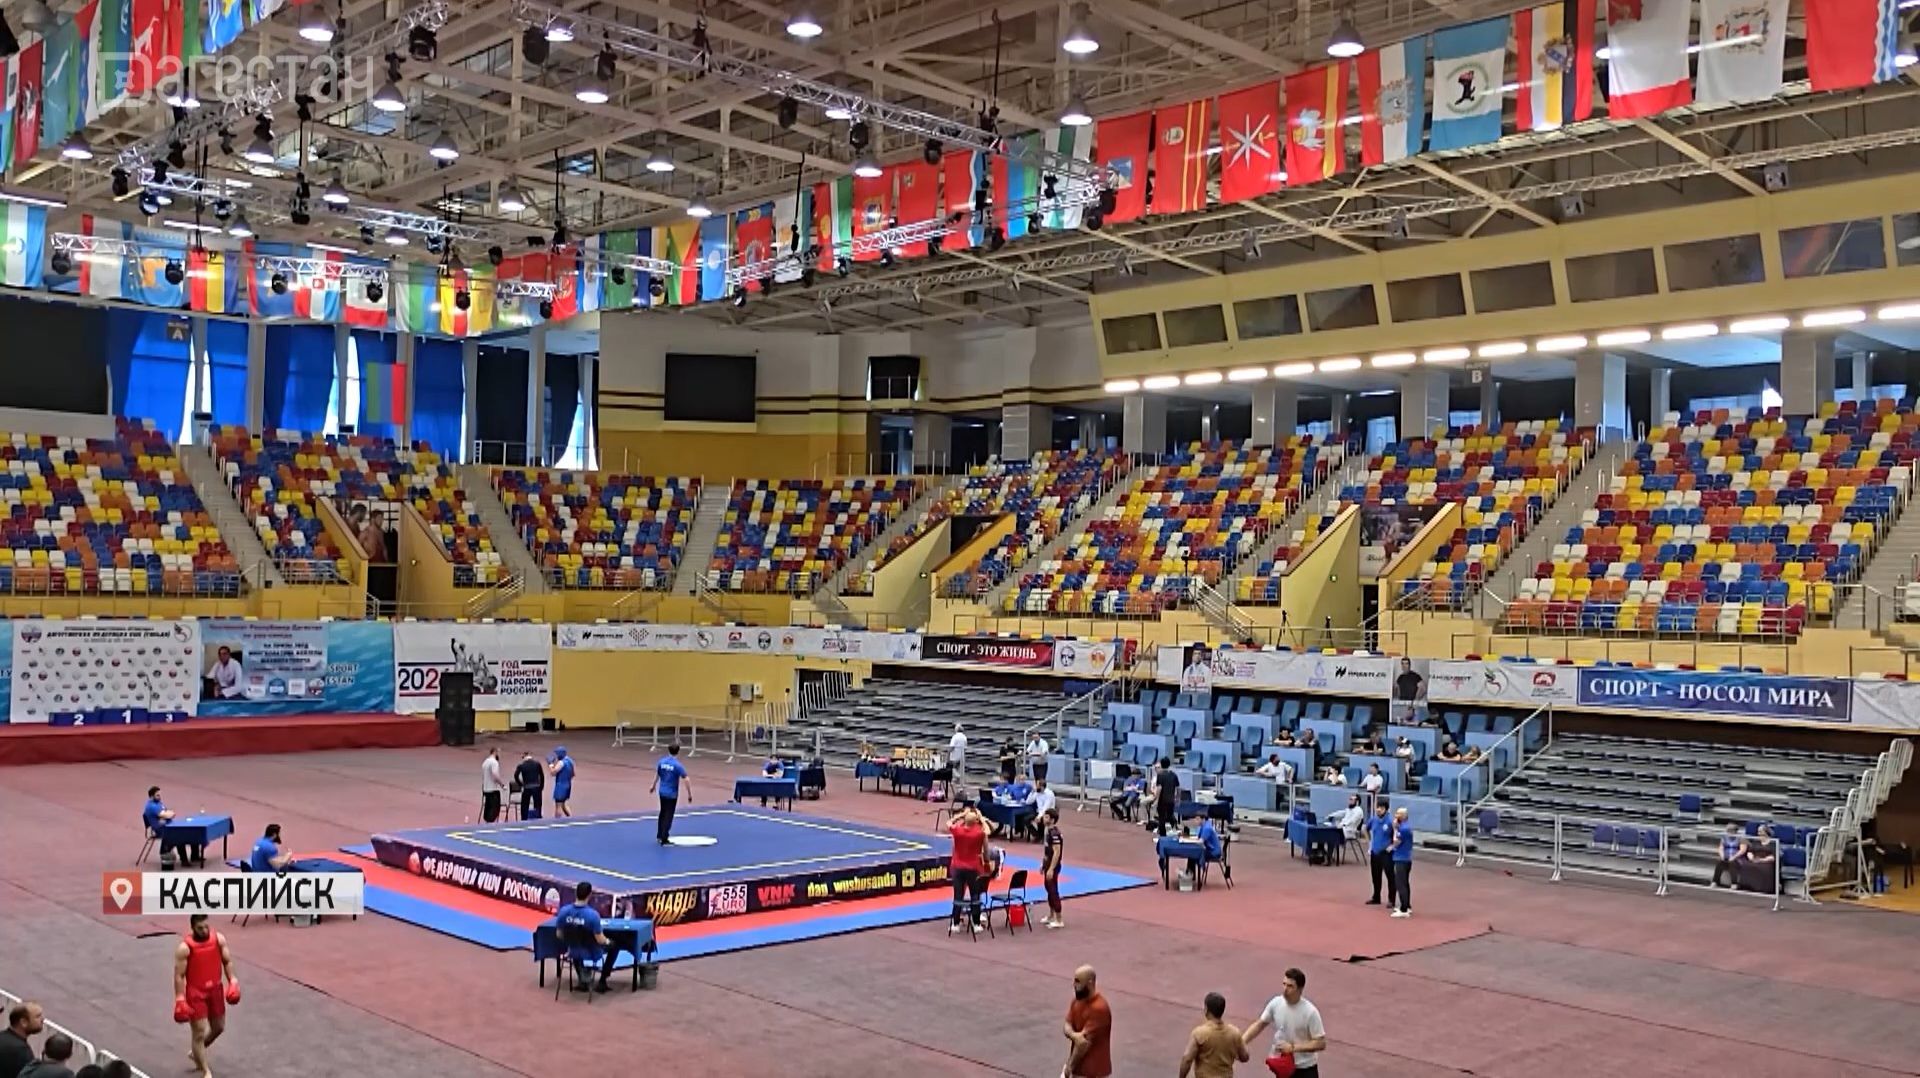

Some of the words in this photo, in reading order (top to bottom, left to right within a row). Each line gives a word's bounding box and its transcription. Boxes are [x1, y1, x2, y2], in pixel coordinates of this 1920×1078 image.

[936, 642, 970, 655] СПОРТ
[976, 645, 997, 656] ЭТО
[999, 646, 1037, 659] ЖИЗНЬ
[501, 660, 519, 669] ГОД
[398, 668, 449, 690] 202
[501, 669, 548, 678] ЕДИНСТВА
[500, 678, 543, 686] НАРОДОВ
[500, 686, 537, 694] РОССИИ
[1589, 678, 1661, 697] СПОРТ
[1679, 683, 1760, 704] ПОСОЛ
[1767, 687, 1834, 708] МИРА
[73, 714, 84, 725] 2
[122, 710, 131, 724] 1
[166, 714, 173, 723] 3
[423, 856, 478, 886] ФЕДЕРАЦИЯ
[478, 871, 501, 895] УШУ
[503, 878, 542, 905] РОССИИ
[722, 886, 746, 901] 555
[646, 889, 697, 913] KHABIB
